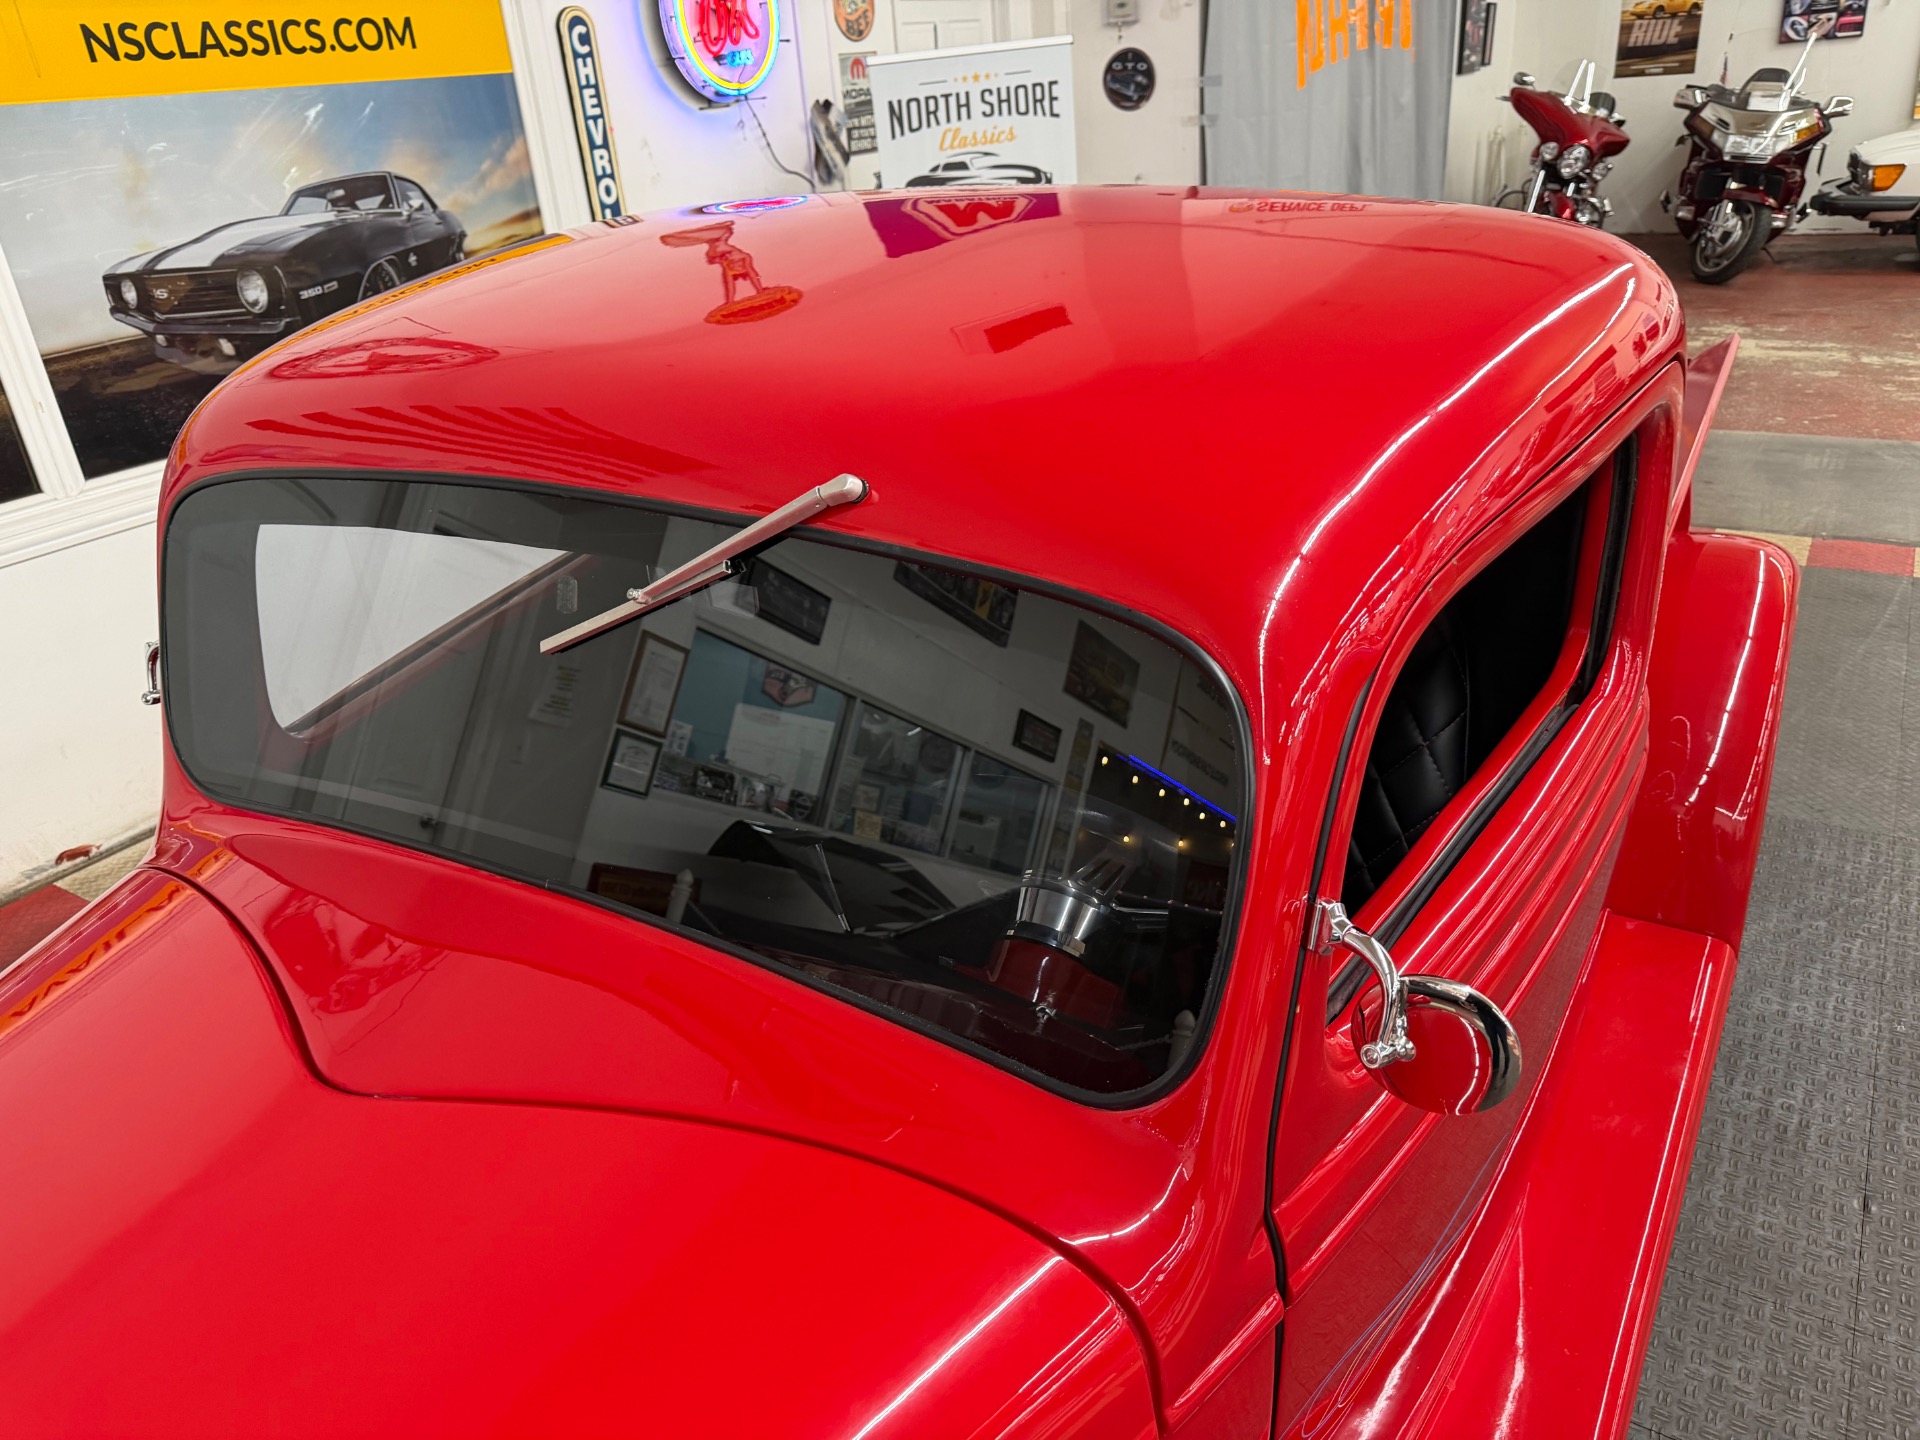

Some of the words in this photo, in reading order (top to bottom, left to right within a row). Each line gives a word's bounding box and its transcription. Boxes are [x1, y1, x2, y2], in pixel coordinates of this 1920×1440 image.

[79, 16, 418, 63] NSCLASSICS.COM
[1627, 17, 1682, 47] RIDE
[888, 91, 972, 141] NORTH
[981, 80, 1060, 118] SHORE
[938, 125, 1016, 151] Classics
